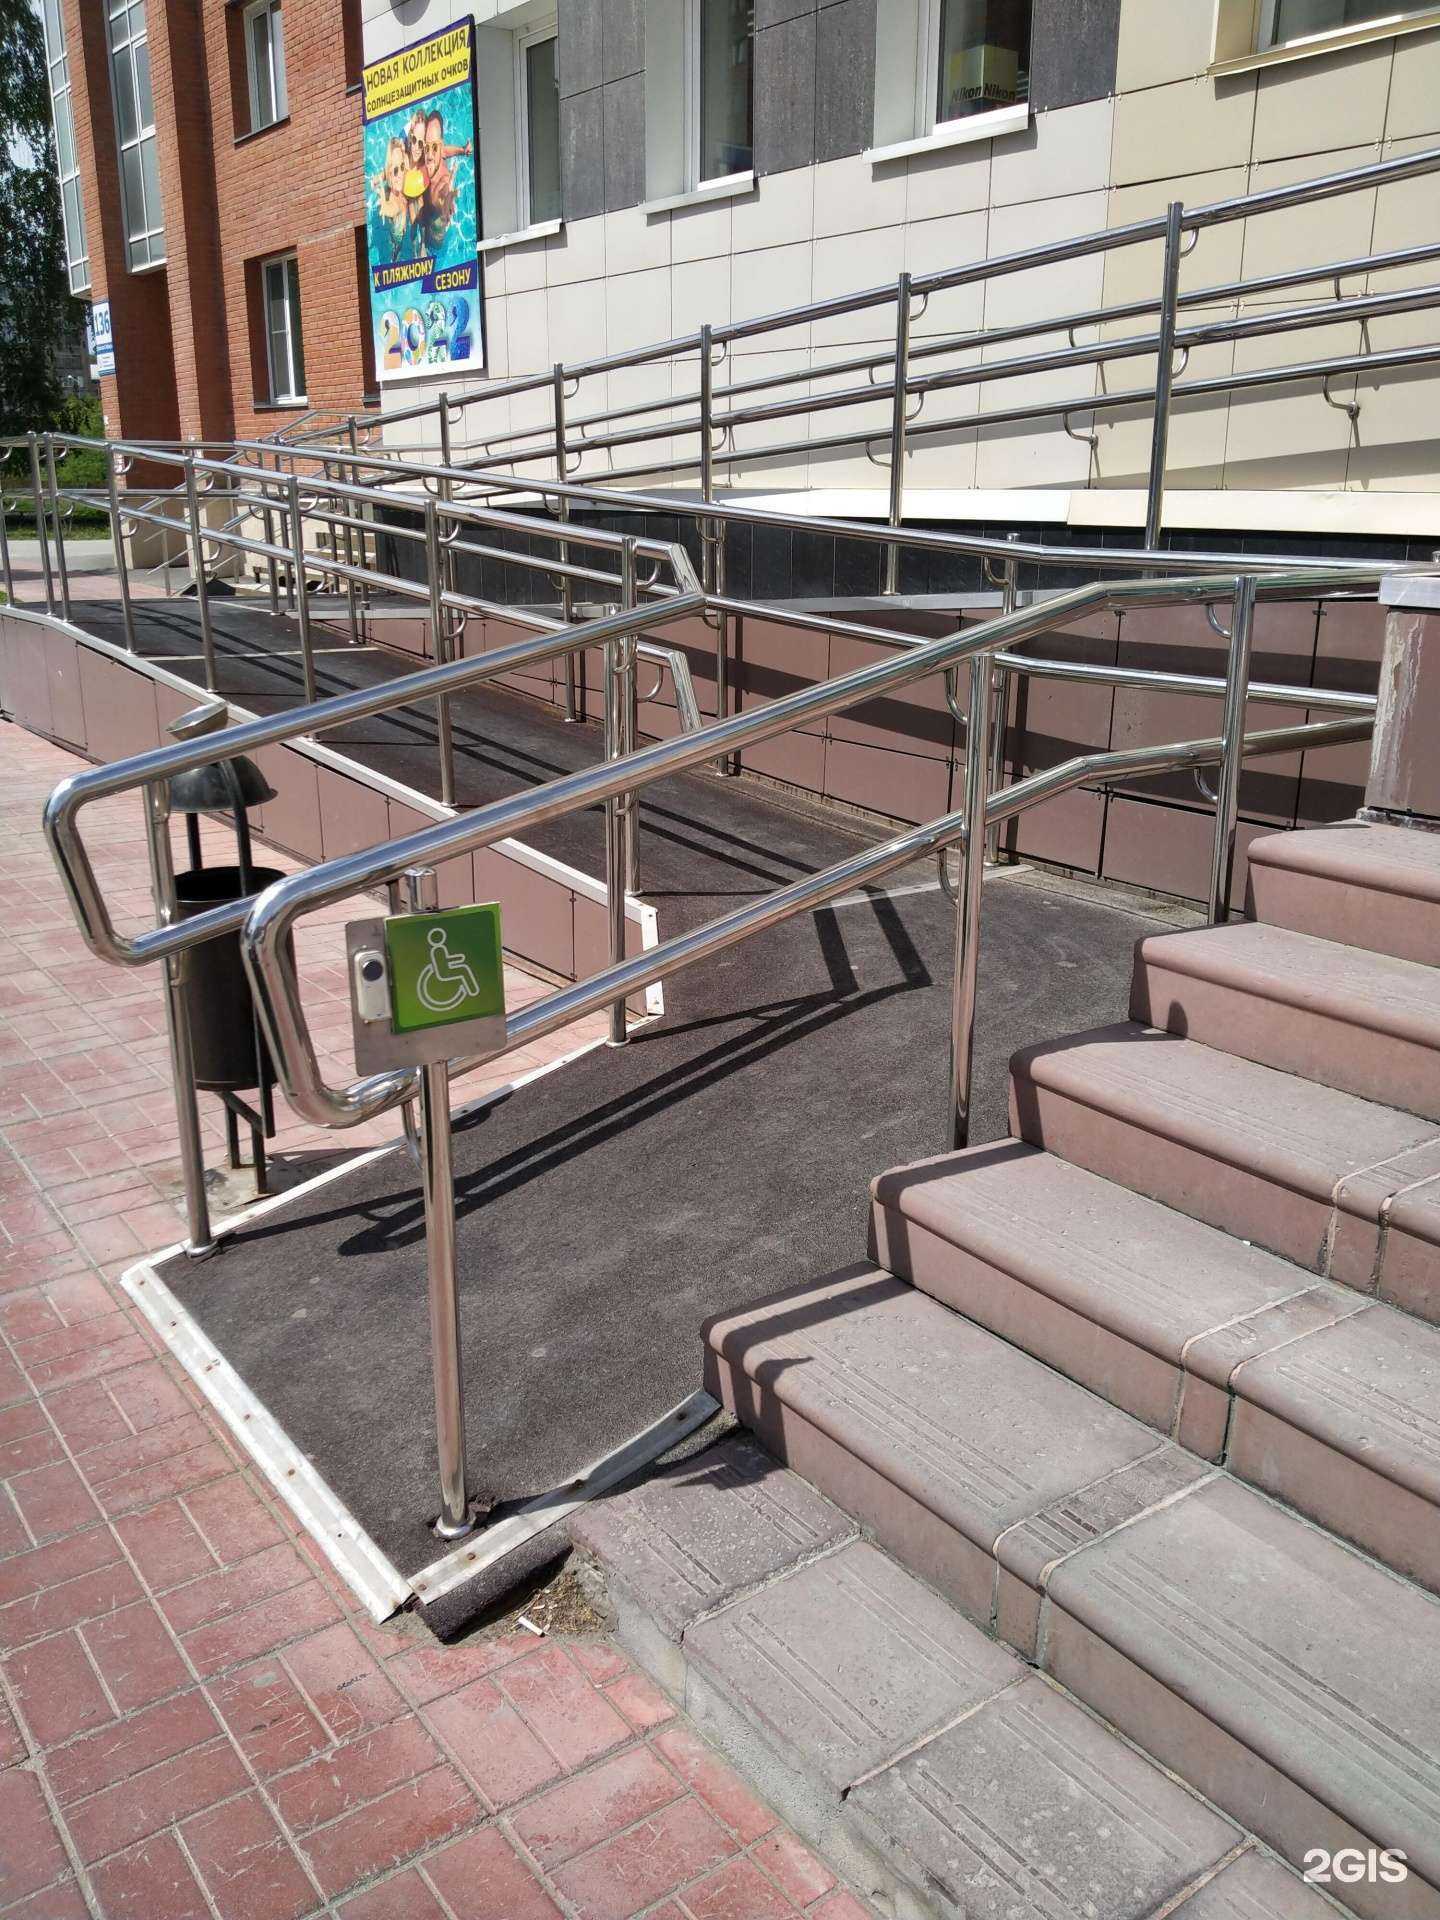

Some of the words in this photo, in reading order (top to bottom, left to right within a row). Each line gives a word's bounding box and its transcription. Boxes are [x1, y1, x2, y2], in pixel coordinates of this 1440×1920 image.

[366, 61, 399, 92] НОВАЯ
[402, 29, 466, 75] КОЛЛЕКЦИЯ
[367, 73, 439, 113] СОЛНЦЕЗАЩИТНЫХ
[441, 59, 469, 80] ОЧКОВ
[952, 86, 982, 102] Nikon
[984, 83, 1016, 101] Nikon
[374, 272, 380, 287] К
[382, 259, 434, 285] ПЛЯЖНОМУ
[435, 268, 471, 290] СЕЗОНУ
[95, 310, 110, 336] 136
[380, 297, 471, 370] 2022
